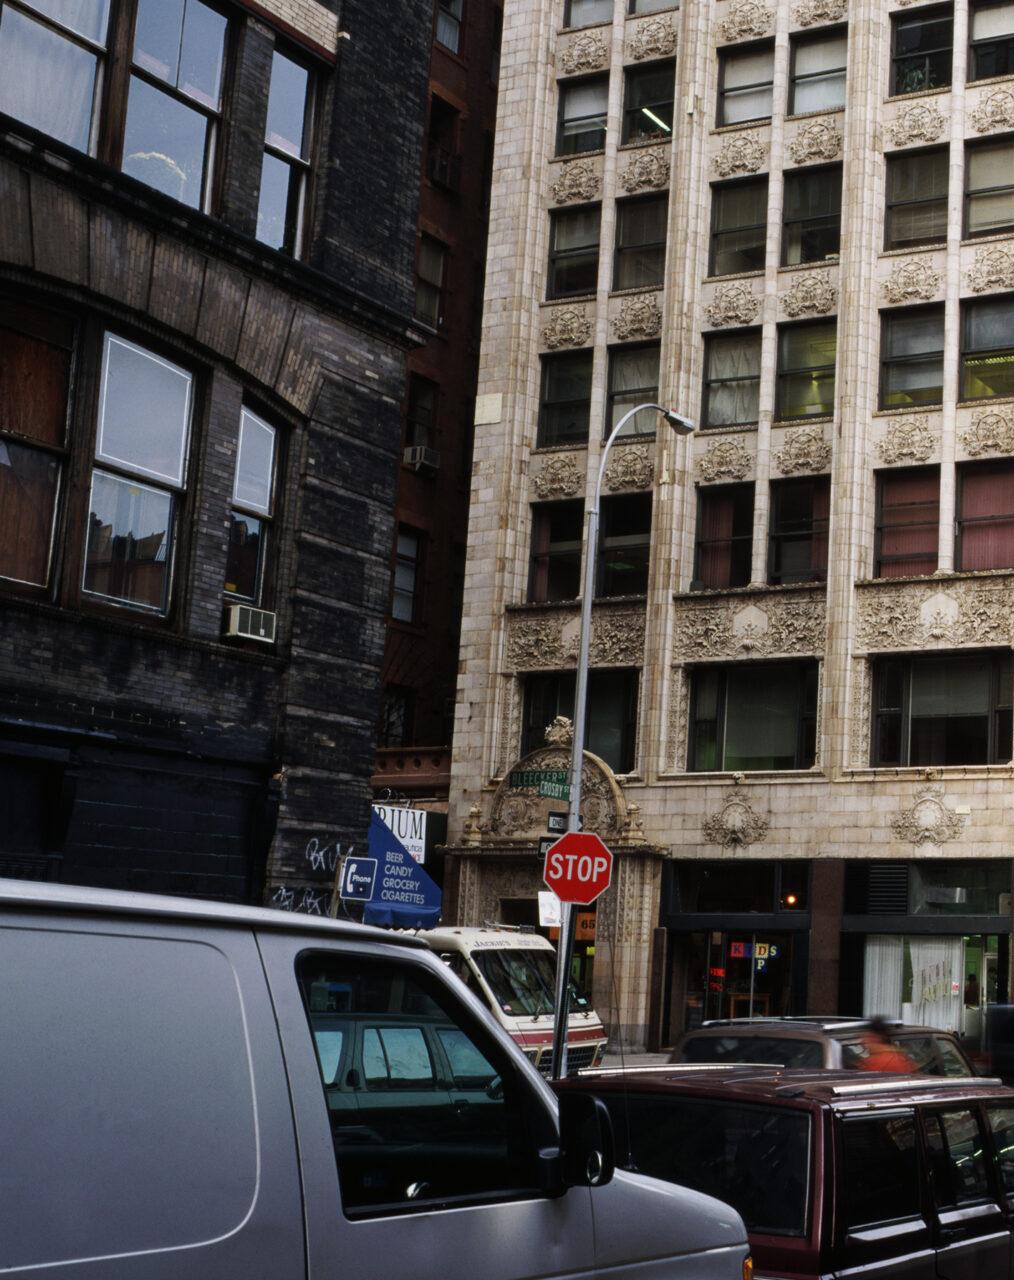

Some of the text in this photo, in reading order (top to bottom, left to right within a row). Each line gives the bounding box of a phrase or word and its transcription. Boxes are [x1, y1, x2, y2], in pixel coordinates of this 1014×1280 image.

[540, 780, 563, 797] CROSBY
[386, 851, 404, 864] BEER
[384, 864, 414, 877] CANDY
[548, 853, 608, 883] STOP
[352, 874, 372, 883] Phone
[382, 877, 420, 891] GROCERY
[381, 890, 425, 904] CIGARETTES
